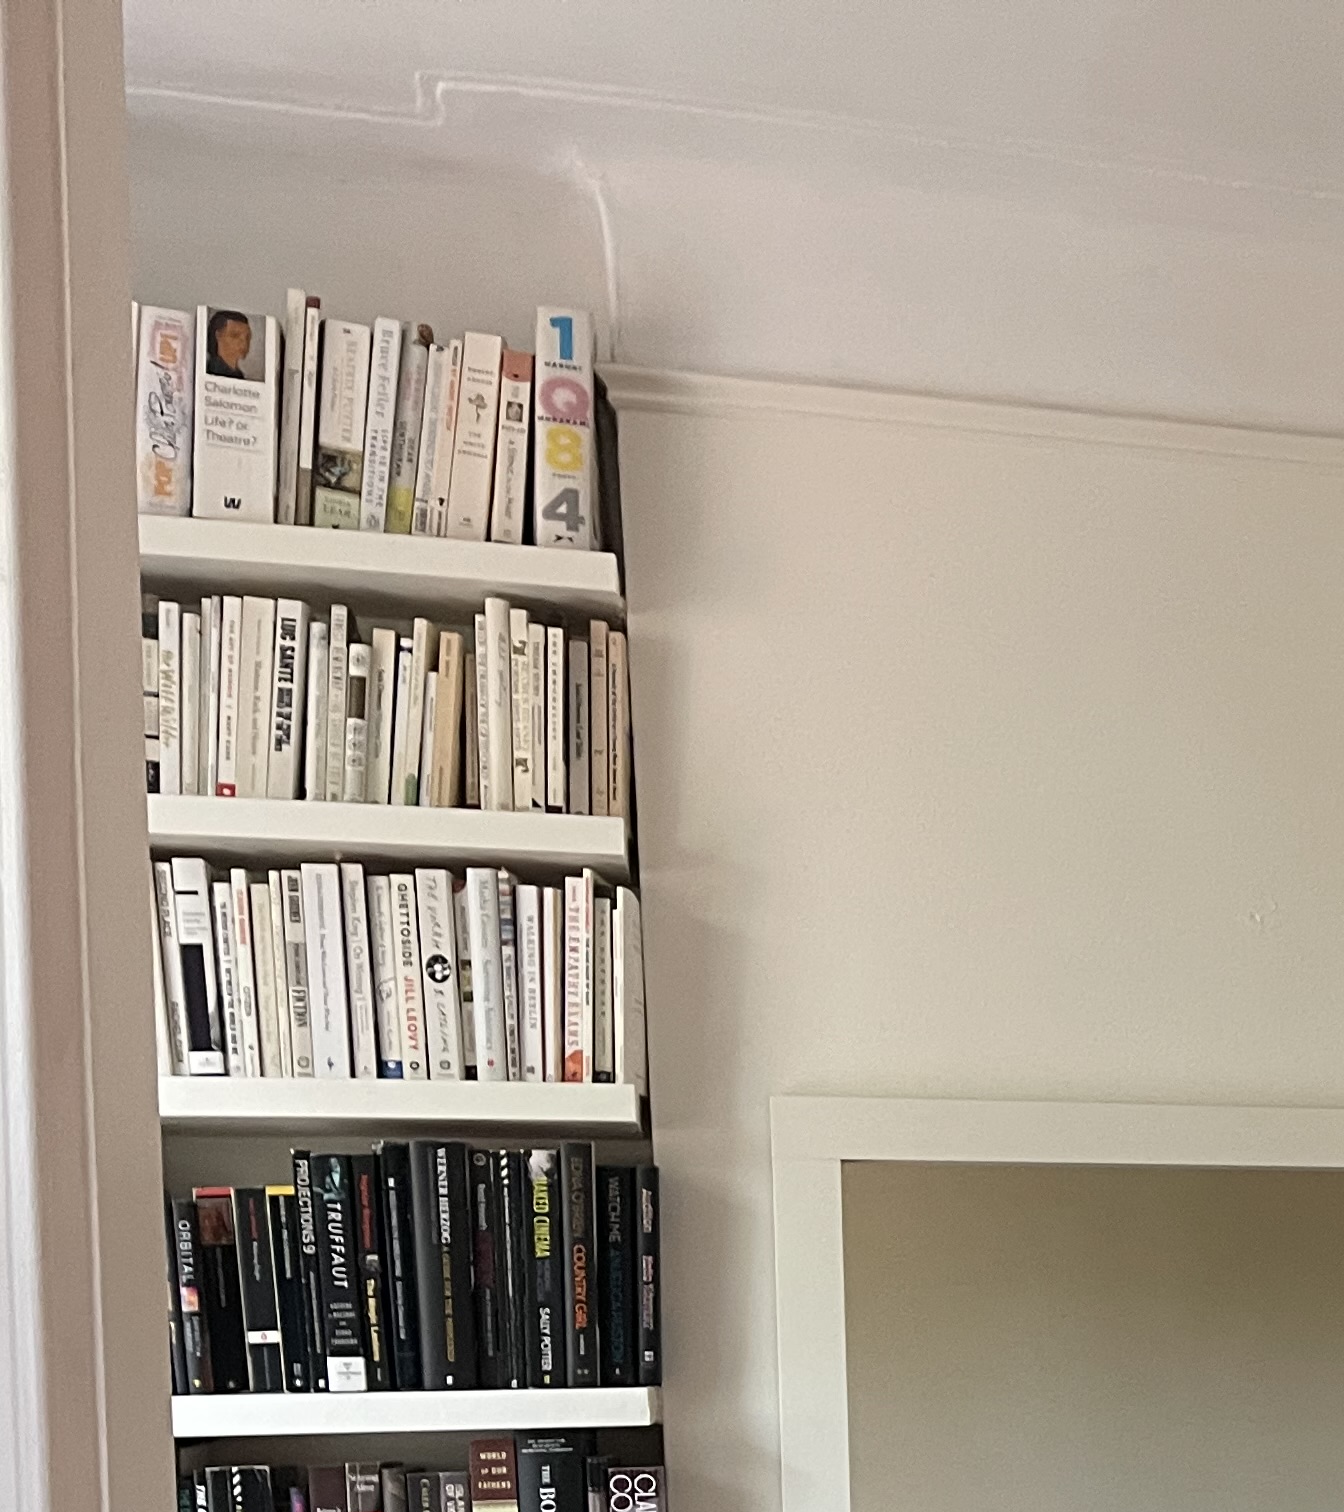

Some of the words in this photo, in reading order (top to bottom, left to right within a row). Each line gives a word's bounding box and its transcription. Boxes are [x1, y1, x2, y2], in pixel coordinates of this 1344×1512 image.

[545, 425, 586, 472] 8
[541, 487, 586, 534] 4
[397, 883, 412, 968] GHETTOSIDE
[296, 1159, 314, 1243] PROJECTIONS
[326, 1202, 349, 1290] TRUFFAUT
